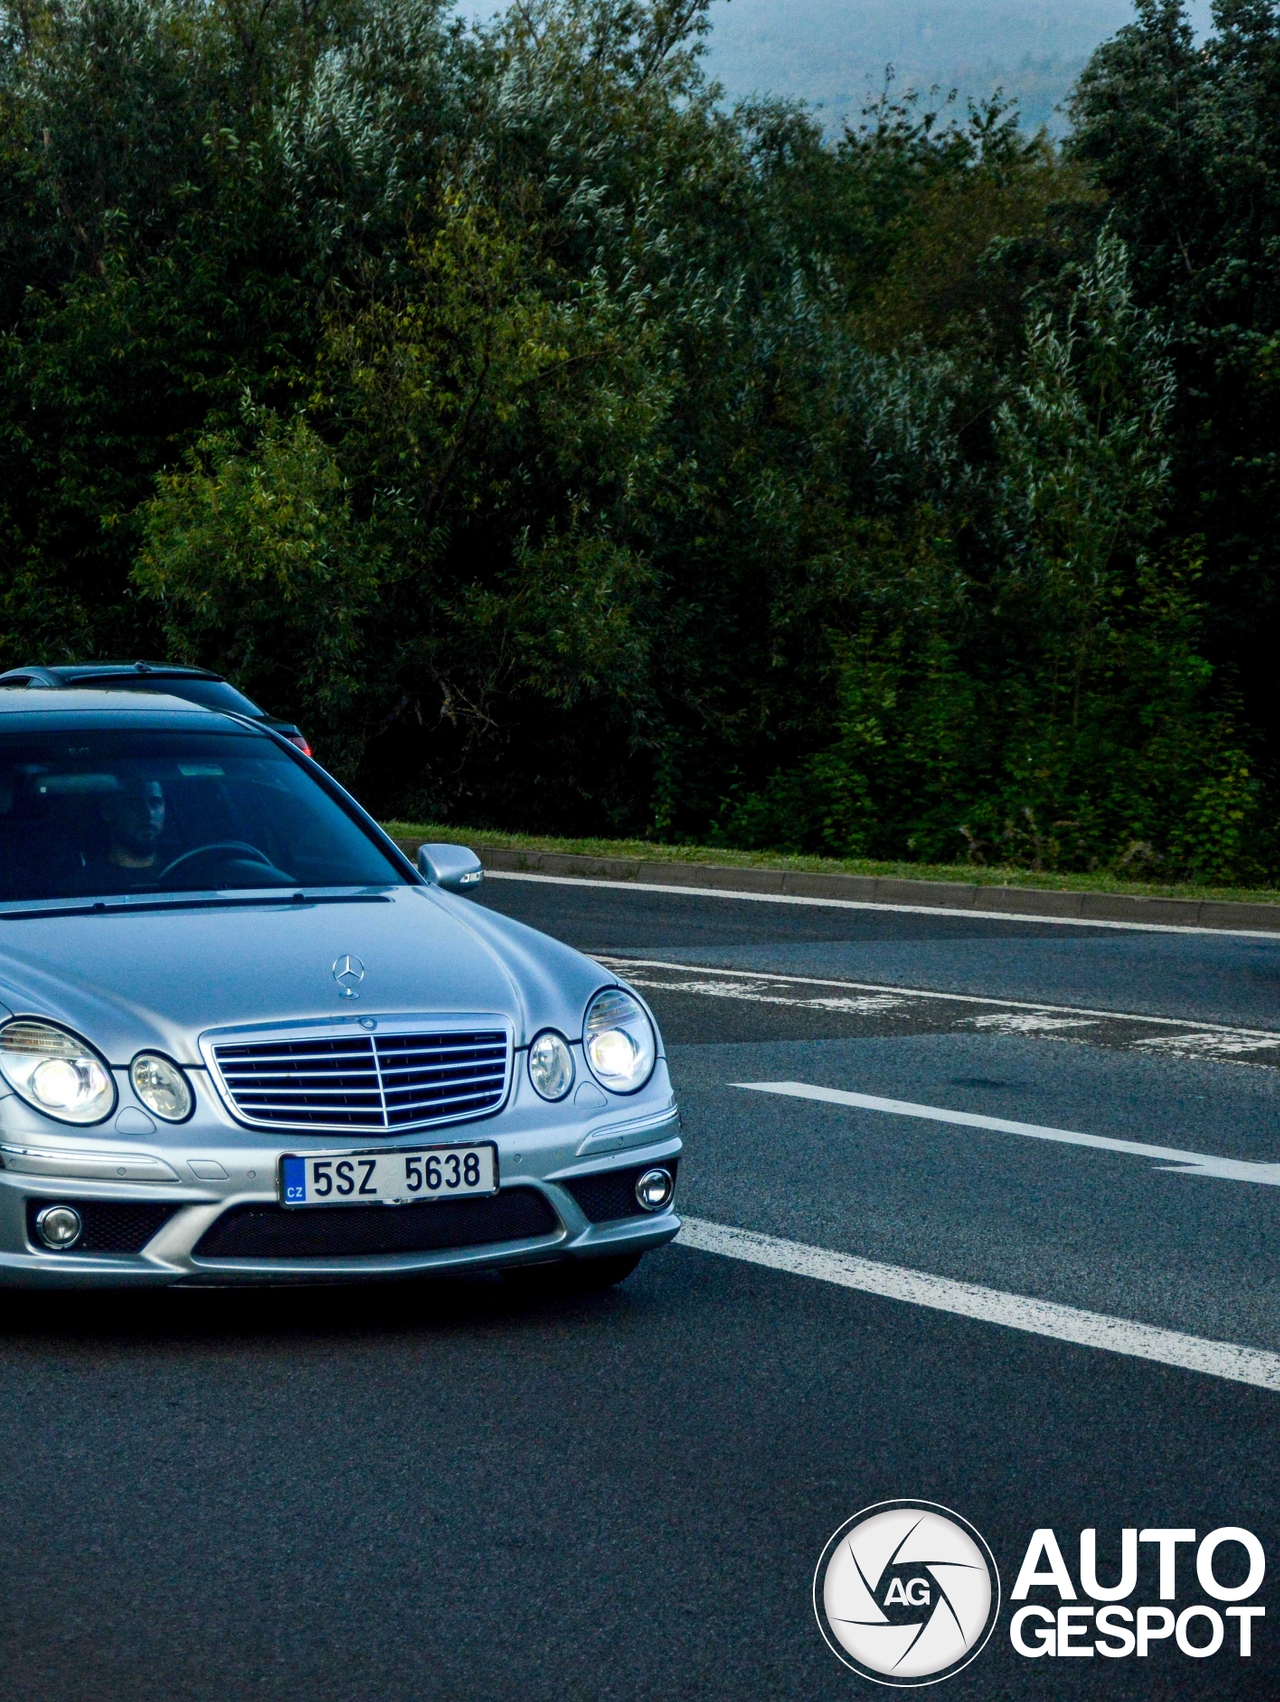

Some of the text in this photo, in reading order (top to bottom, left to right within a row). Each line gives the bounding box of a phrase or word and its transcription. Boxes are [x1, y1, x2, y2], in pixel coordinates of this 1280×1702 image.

[287, 1152, 481, 1198] CZ 5SZ 5638
